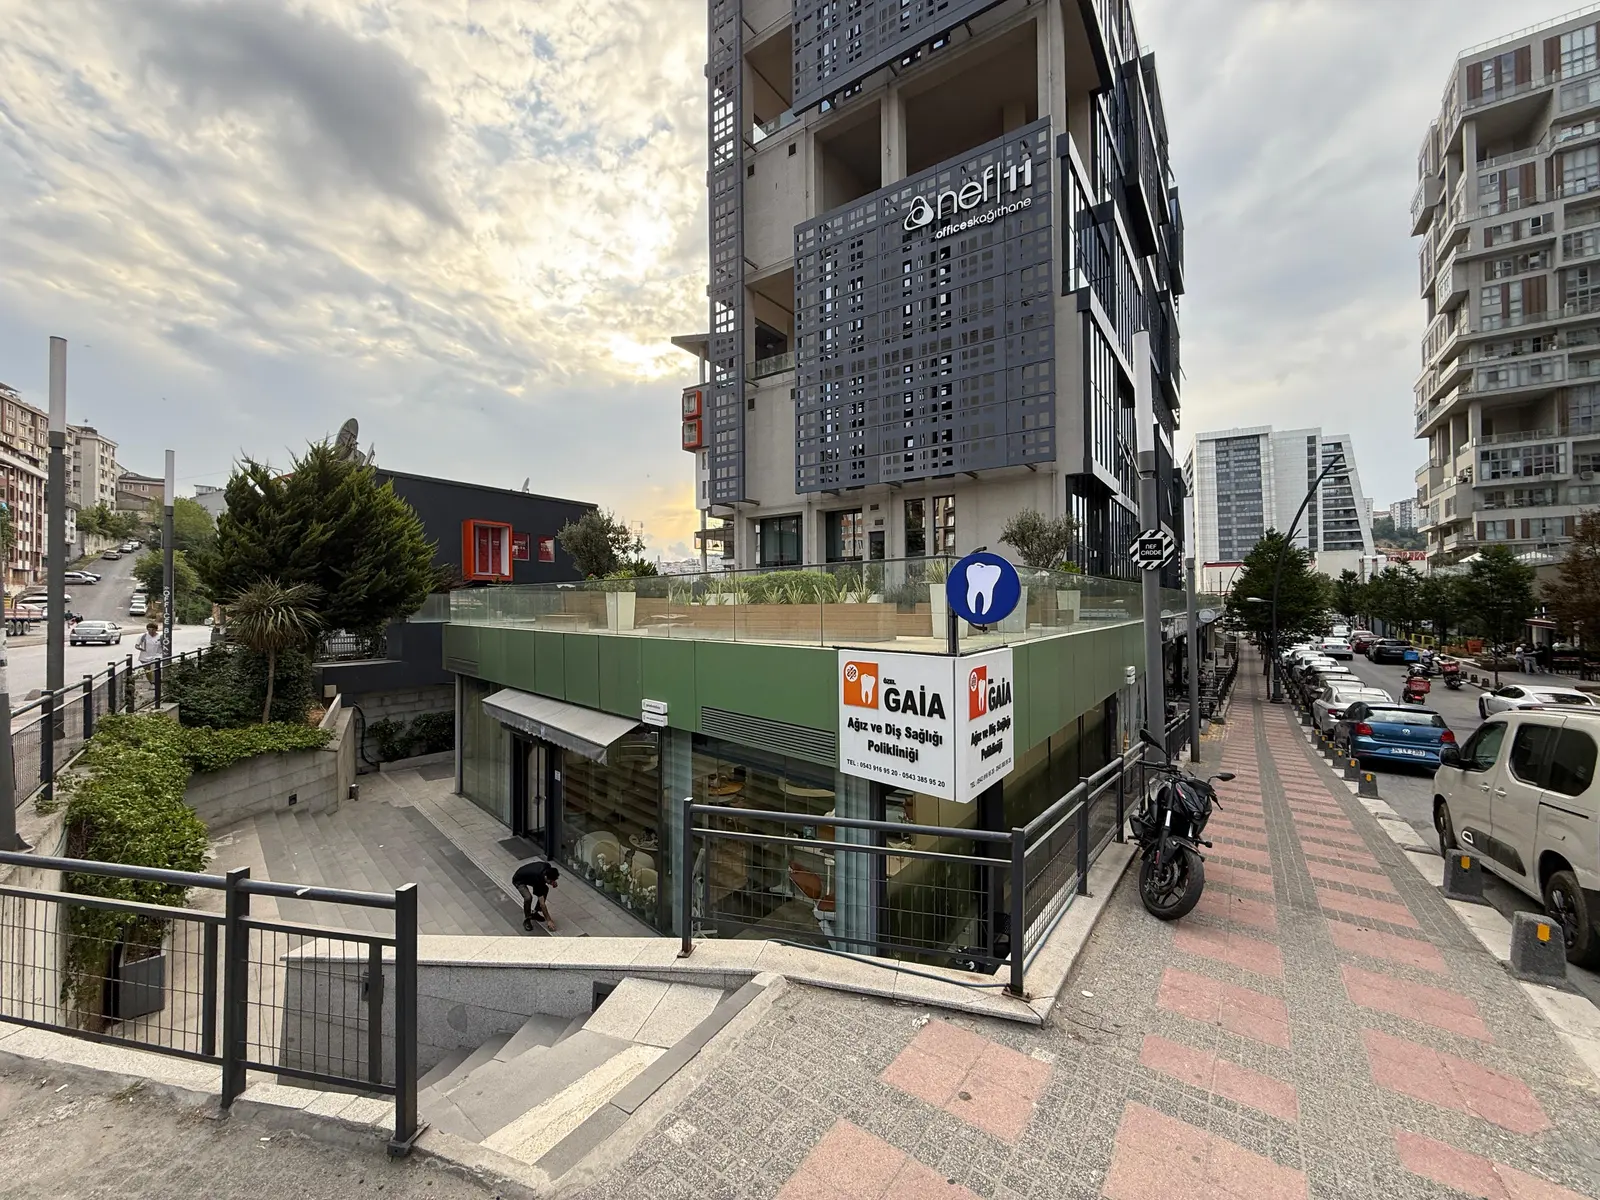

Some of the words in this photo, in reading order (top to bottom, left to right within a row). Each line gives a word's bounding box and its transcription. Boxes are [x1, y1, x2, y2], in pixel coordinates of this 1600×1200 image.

[884, 685, 946, 720] GAİA
[988, 677, 1012, 712] GAİA
[847, 716, 868, 732] Ağız
[870, 723, 882, 733] ve
[885, 723, 901, 740] Diş
[905, 726, 943, 747] Sağlığı
[868, 739, 919, 763] Polikliniği
[847, 758, 856, 766] TEL
[860, 761, 872, 770] 0543
[883, 767, 890, 775] 95
[902, 771, 916, 781] 0543
[928, 778, 936, 786] 95
